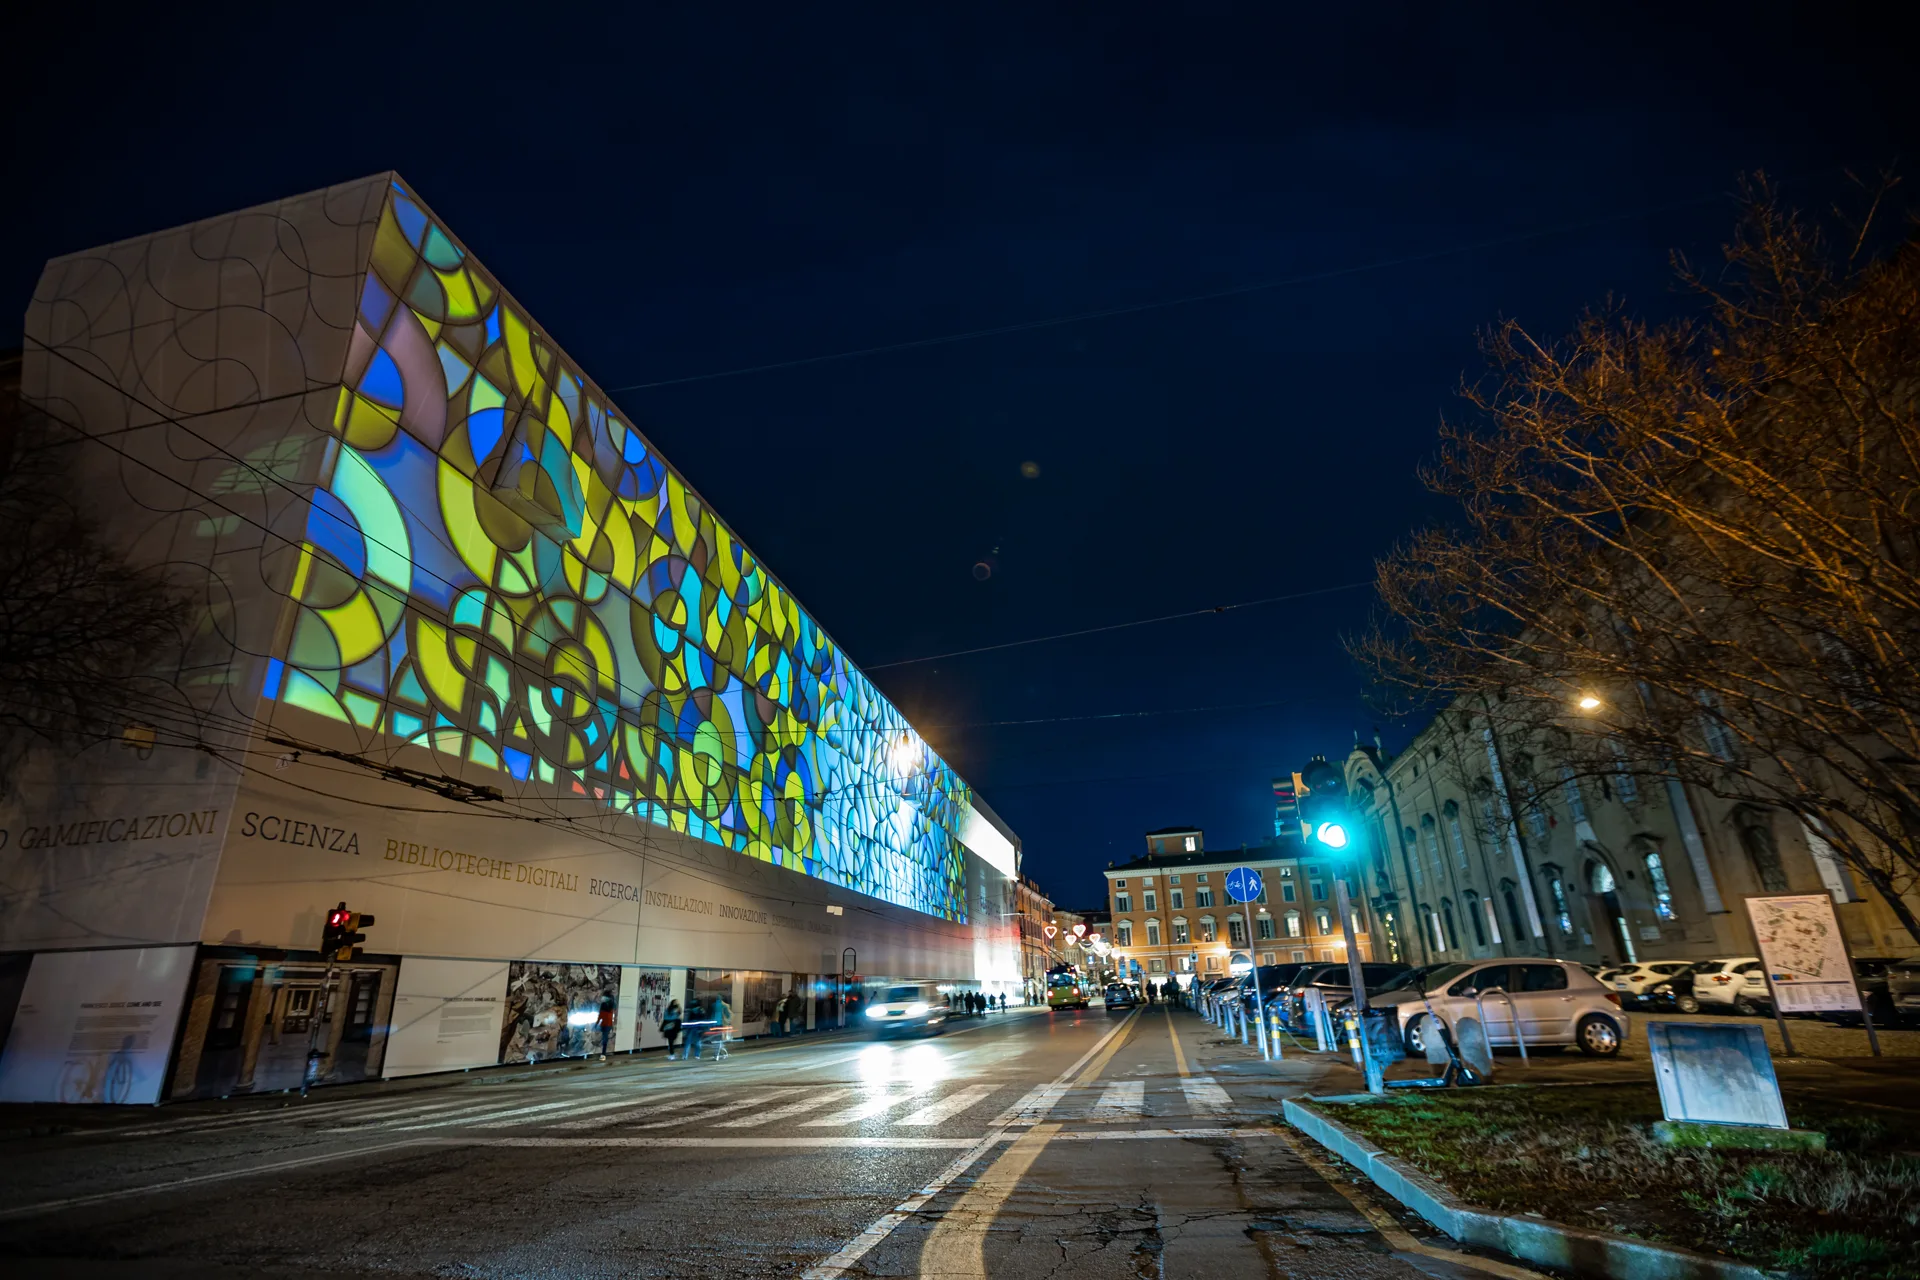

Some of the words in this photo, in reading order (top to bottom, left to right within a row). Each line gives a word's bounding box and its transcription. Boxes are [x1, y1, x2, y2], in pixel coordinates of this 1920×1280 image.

[19, 810, 219, 850] GAMIFICAZIONI
[241, 811, 360, 855] SCIENZA
[384, 838, 513, 881] BIBLIOTECHE
[515, 863, 579, 893] DIGITALI
[589, 878, 639, 902] RICERCA
[644, 889, 714, 916] INSTALLAZIONI
[719, 903, 768, 925] INNOVAZIONE
